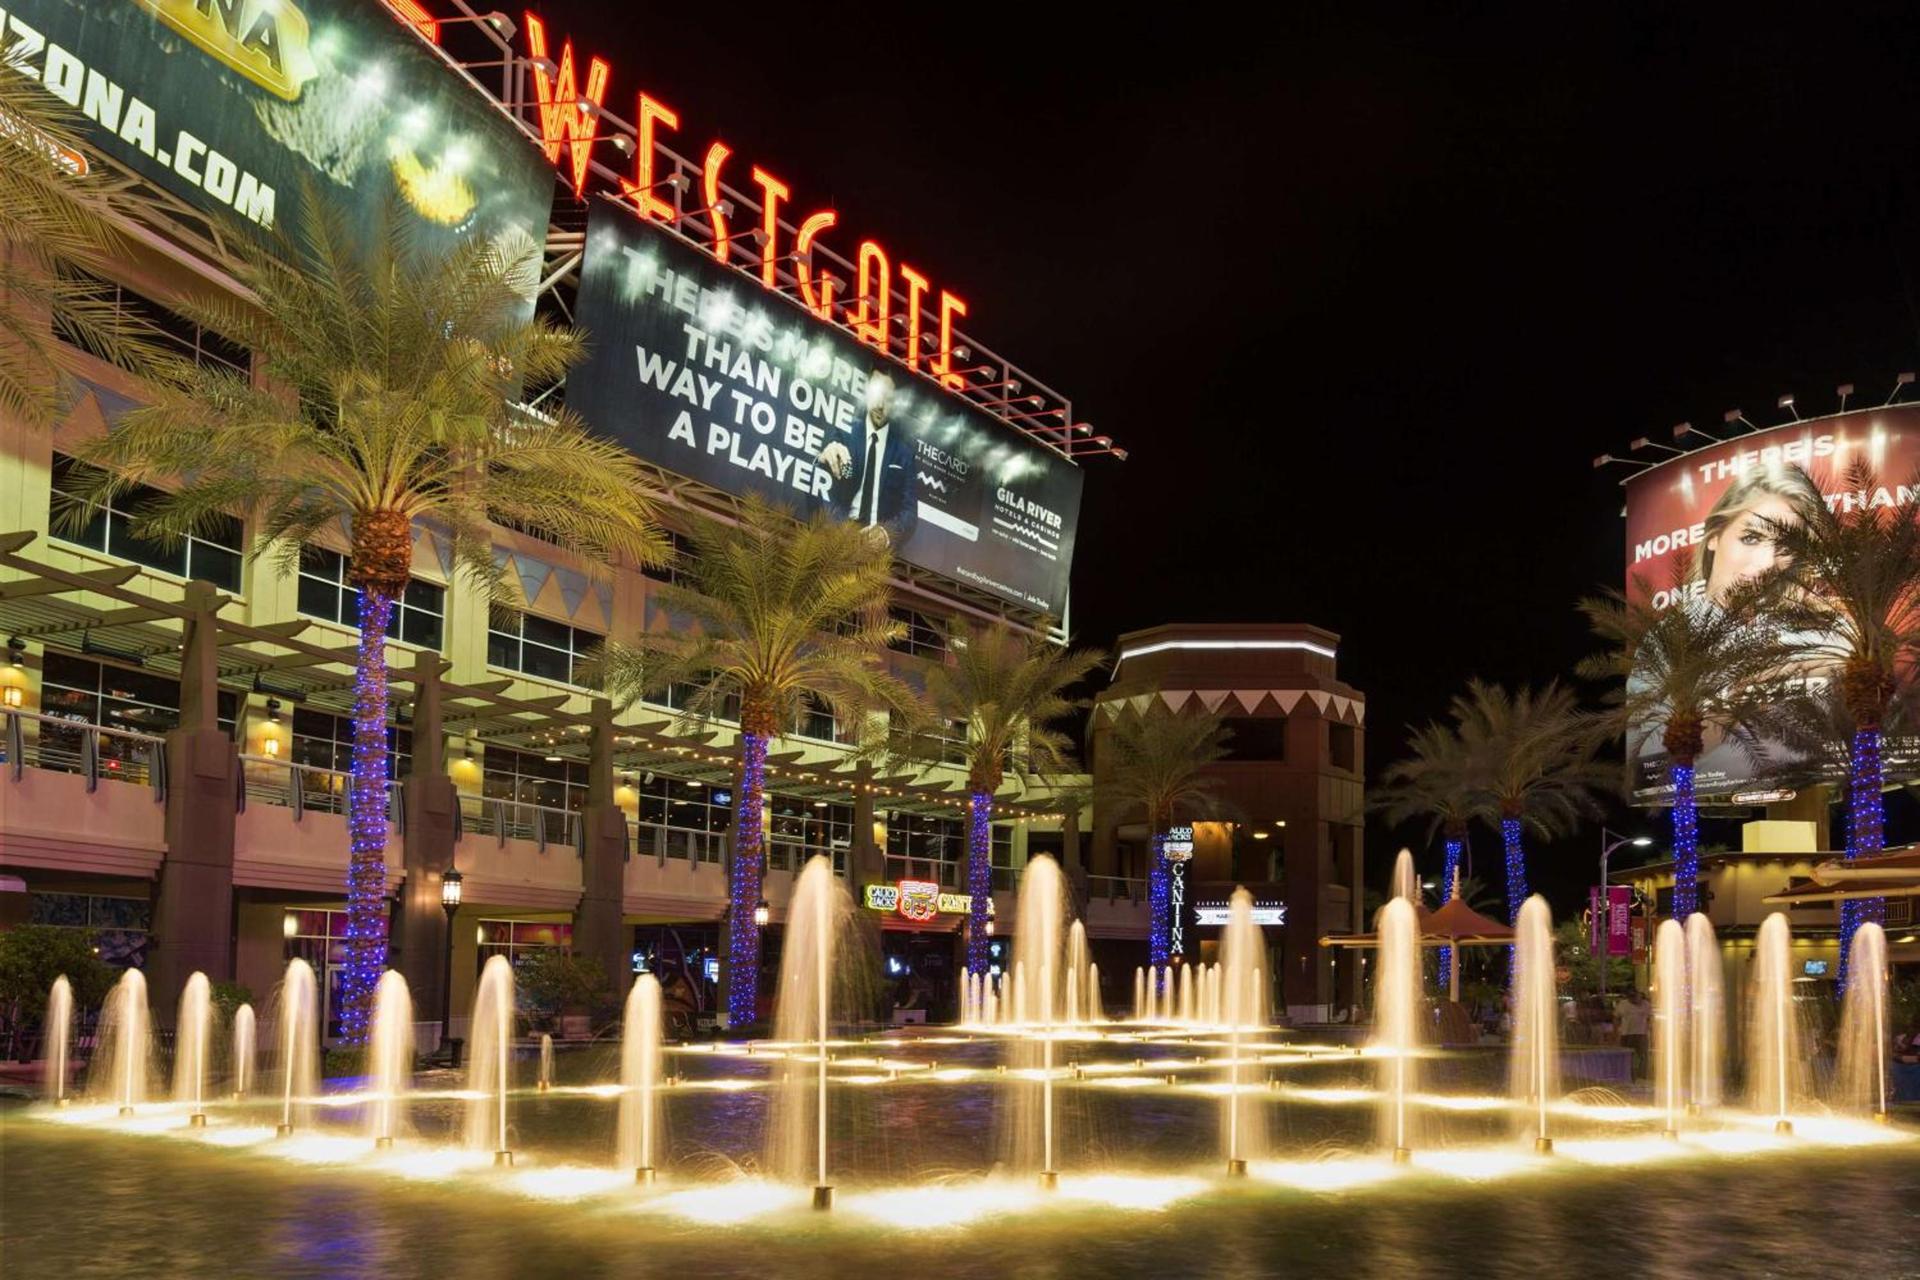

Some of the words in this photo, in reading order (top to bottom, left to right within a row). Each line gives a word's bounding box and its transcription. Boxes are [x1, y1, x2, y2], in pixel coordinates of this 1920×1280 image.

[526, 12, 967, 392] WESTGATE
[636, 345, 722, 411] WAY
[731, 389, 776, 435] TO
[784, 414, 825, 456] BE
[684, 323, 781, 398] THAN
[789, 378, 855, 433] ONE
[782, 330, 870, 403] MORE
[668, 410, 696, 448] A
[707, 423, 833, 502] PLAYER
[995, 504, 1022, 521] HOTELS
[997, 487, 1025, 512] GILA
[1027, 501, 1062, 530] RIVER
[1635, 522, 1706, 563] MORE
[1652, 579, 1706, 611] ONE
[938, 893, 995, 915] CANTIA
[1171, 863, 1185, 954] CANTINA
